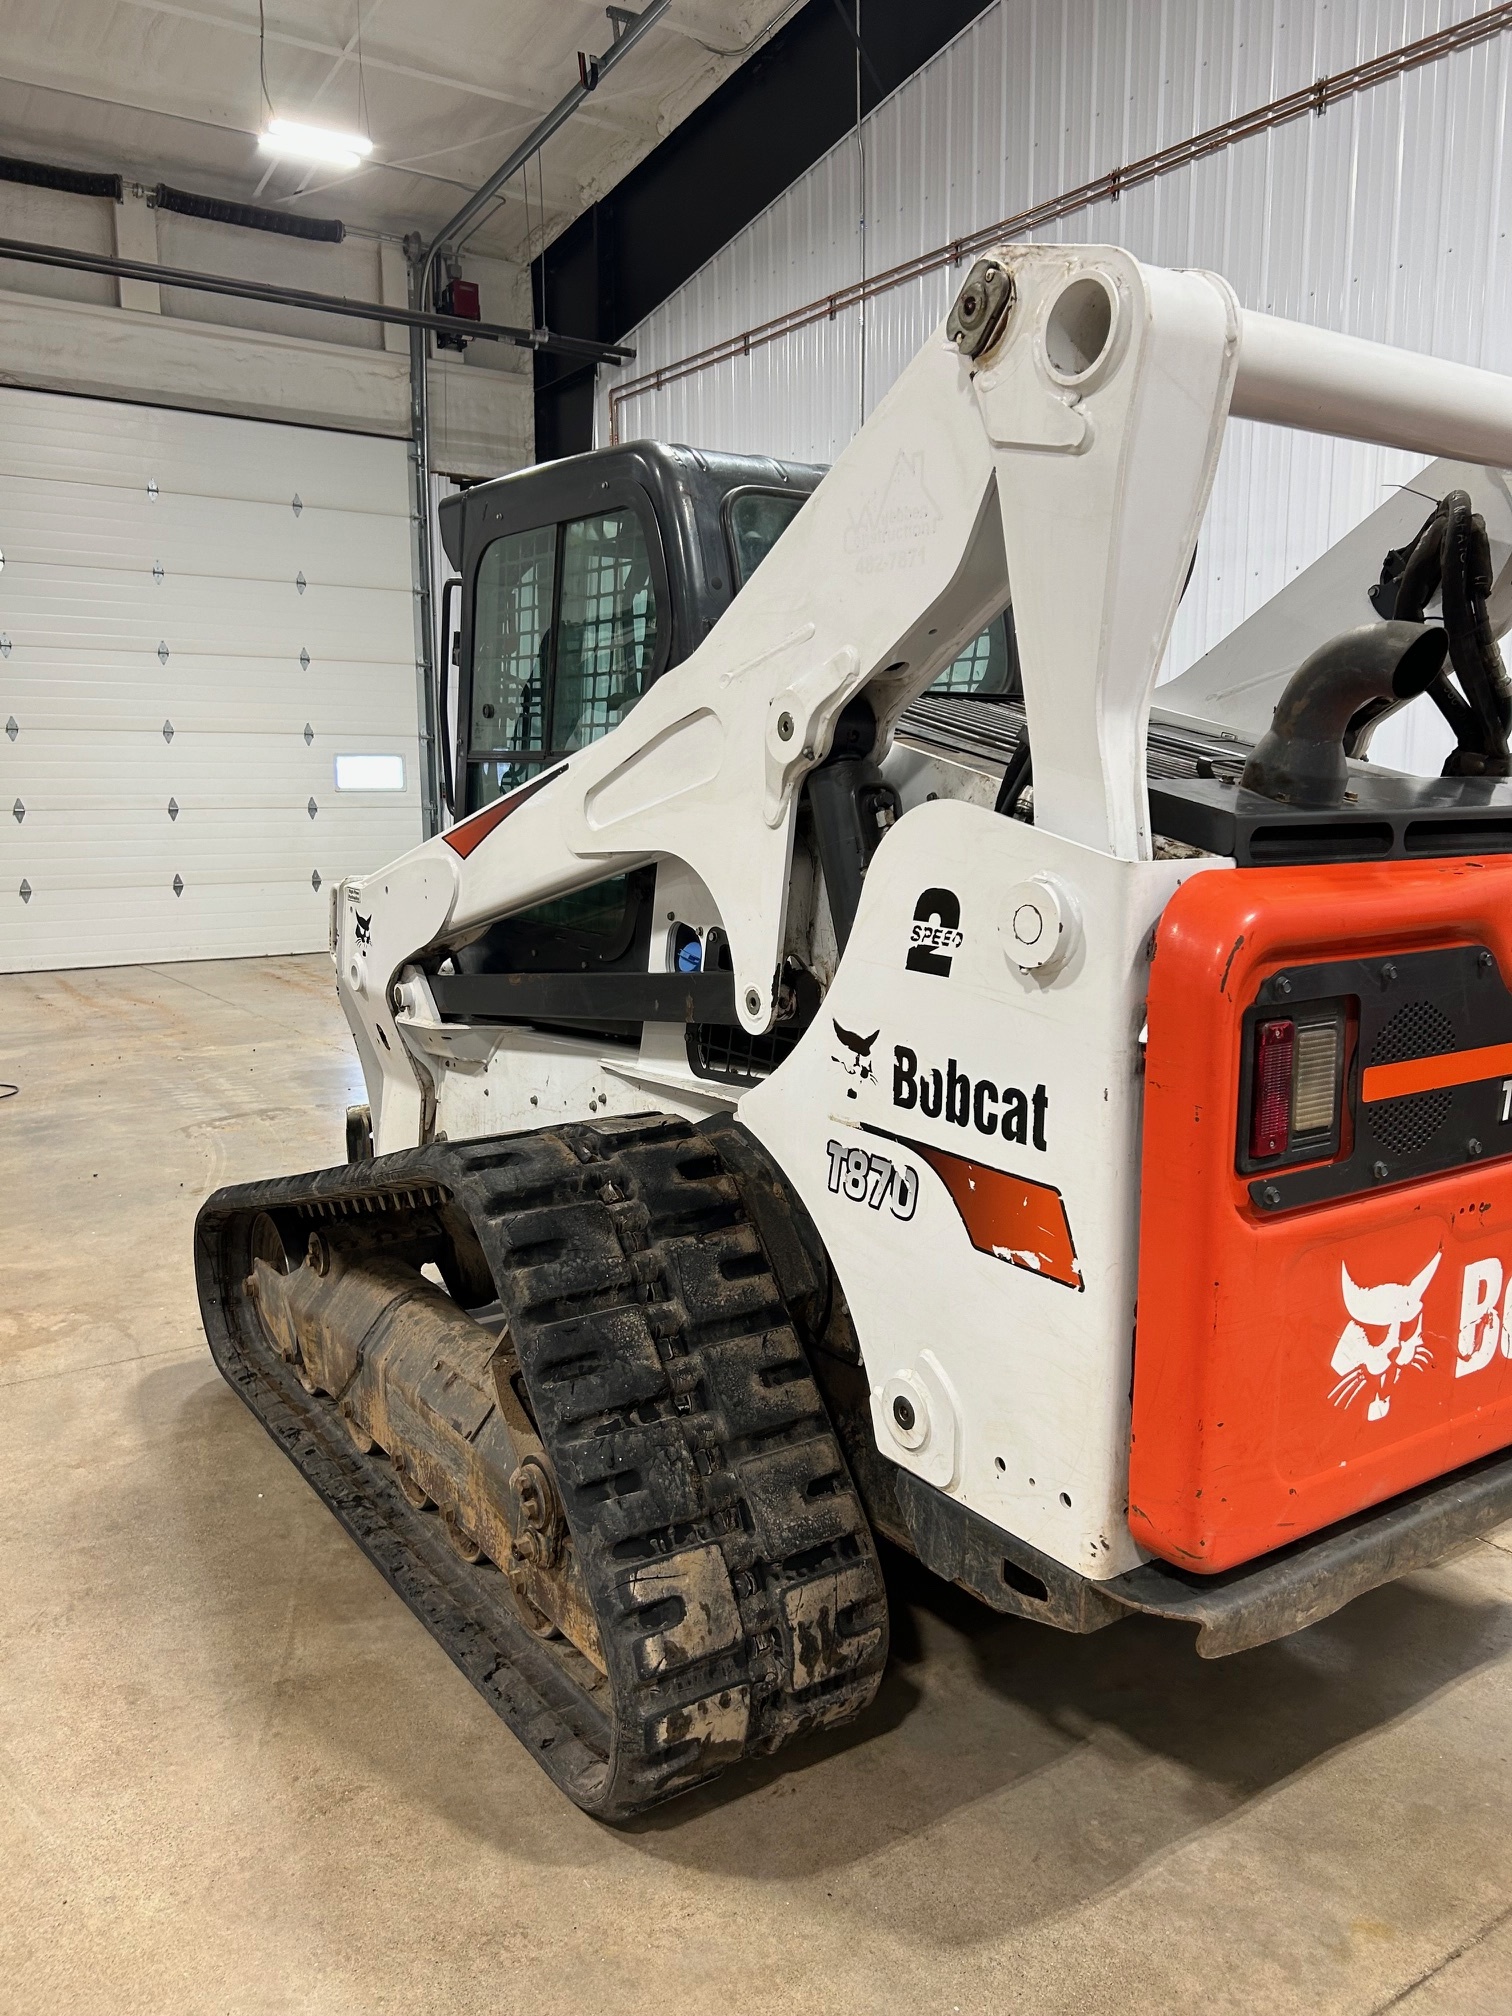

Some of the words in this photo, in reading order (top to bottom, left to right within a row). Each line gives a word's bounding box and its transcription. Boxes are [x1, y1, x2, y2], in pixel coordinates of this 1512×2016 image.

[910, 924, 963, 948] SPEED
[893, 1044, 1049, 1151] Bobcat
[827, 1139, 919, 1221] T870
